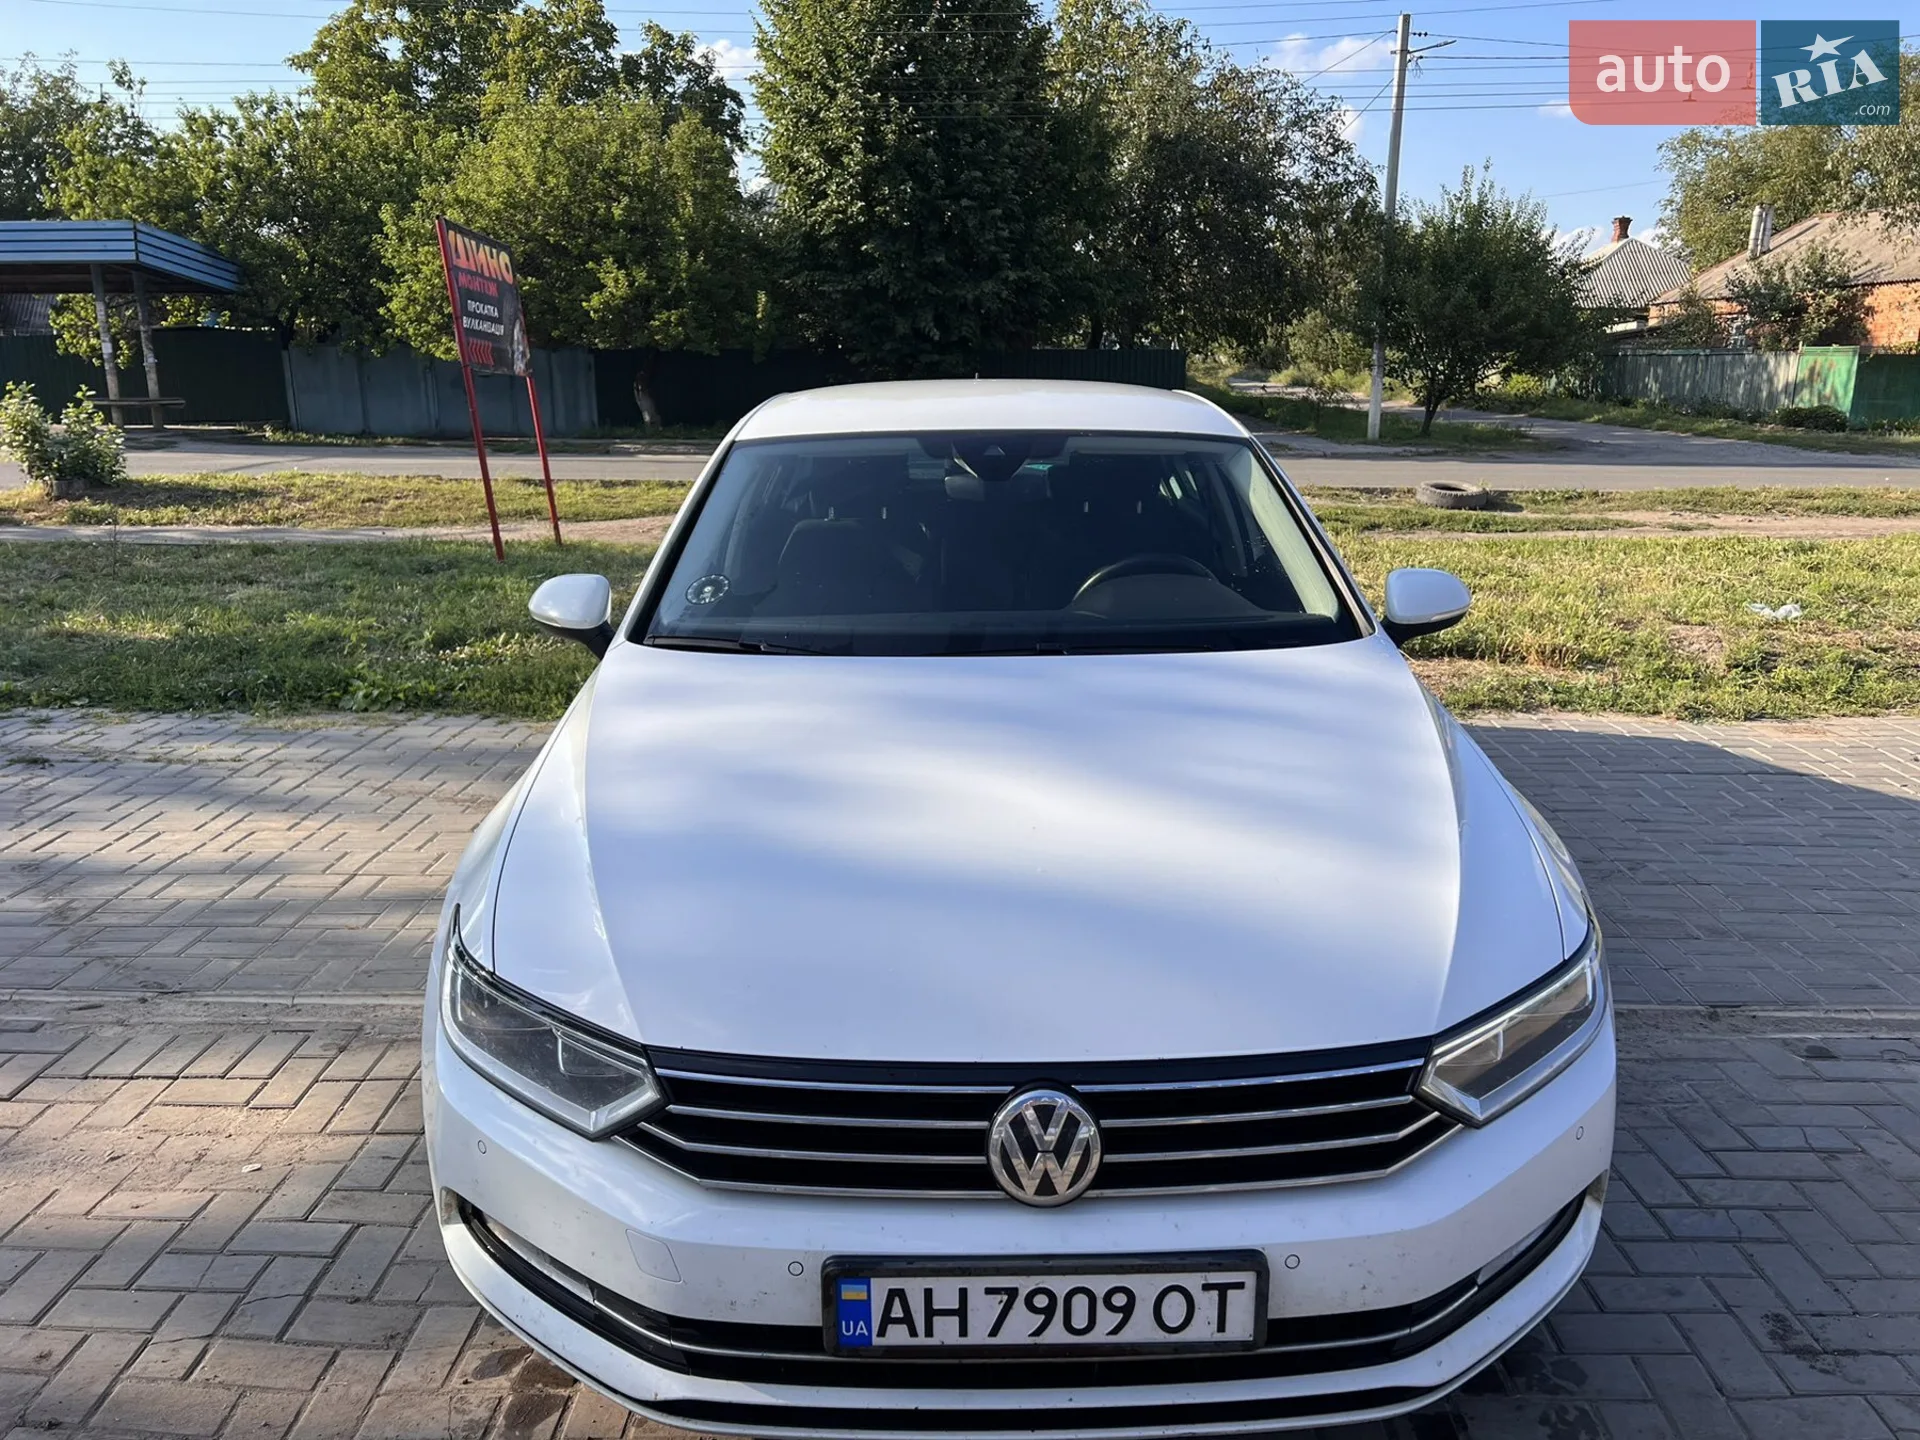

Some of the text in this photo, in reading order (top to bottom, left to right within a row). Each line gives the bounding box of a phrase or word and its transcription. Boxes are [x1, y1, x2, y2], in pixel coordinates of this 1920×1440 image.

[447, 229, 514, 285] ШИНО
[467, 300, 499, 318] ПРОКАТКА
[997, 1096, 1094, 1201] VW
[841, 1320, 869, 1338] UA
